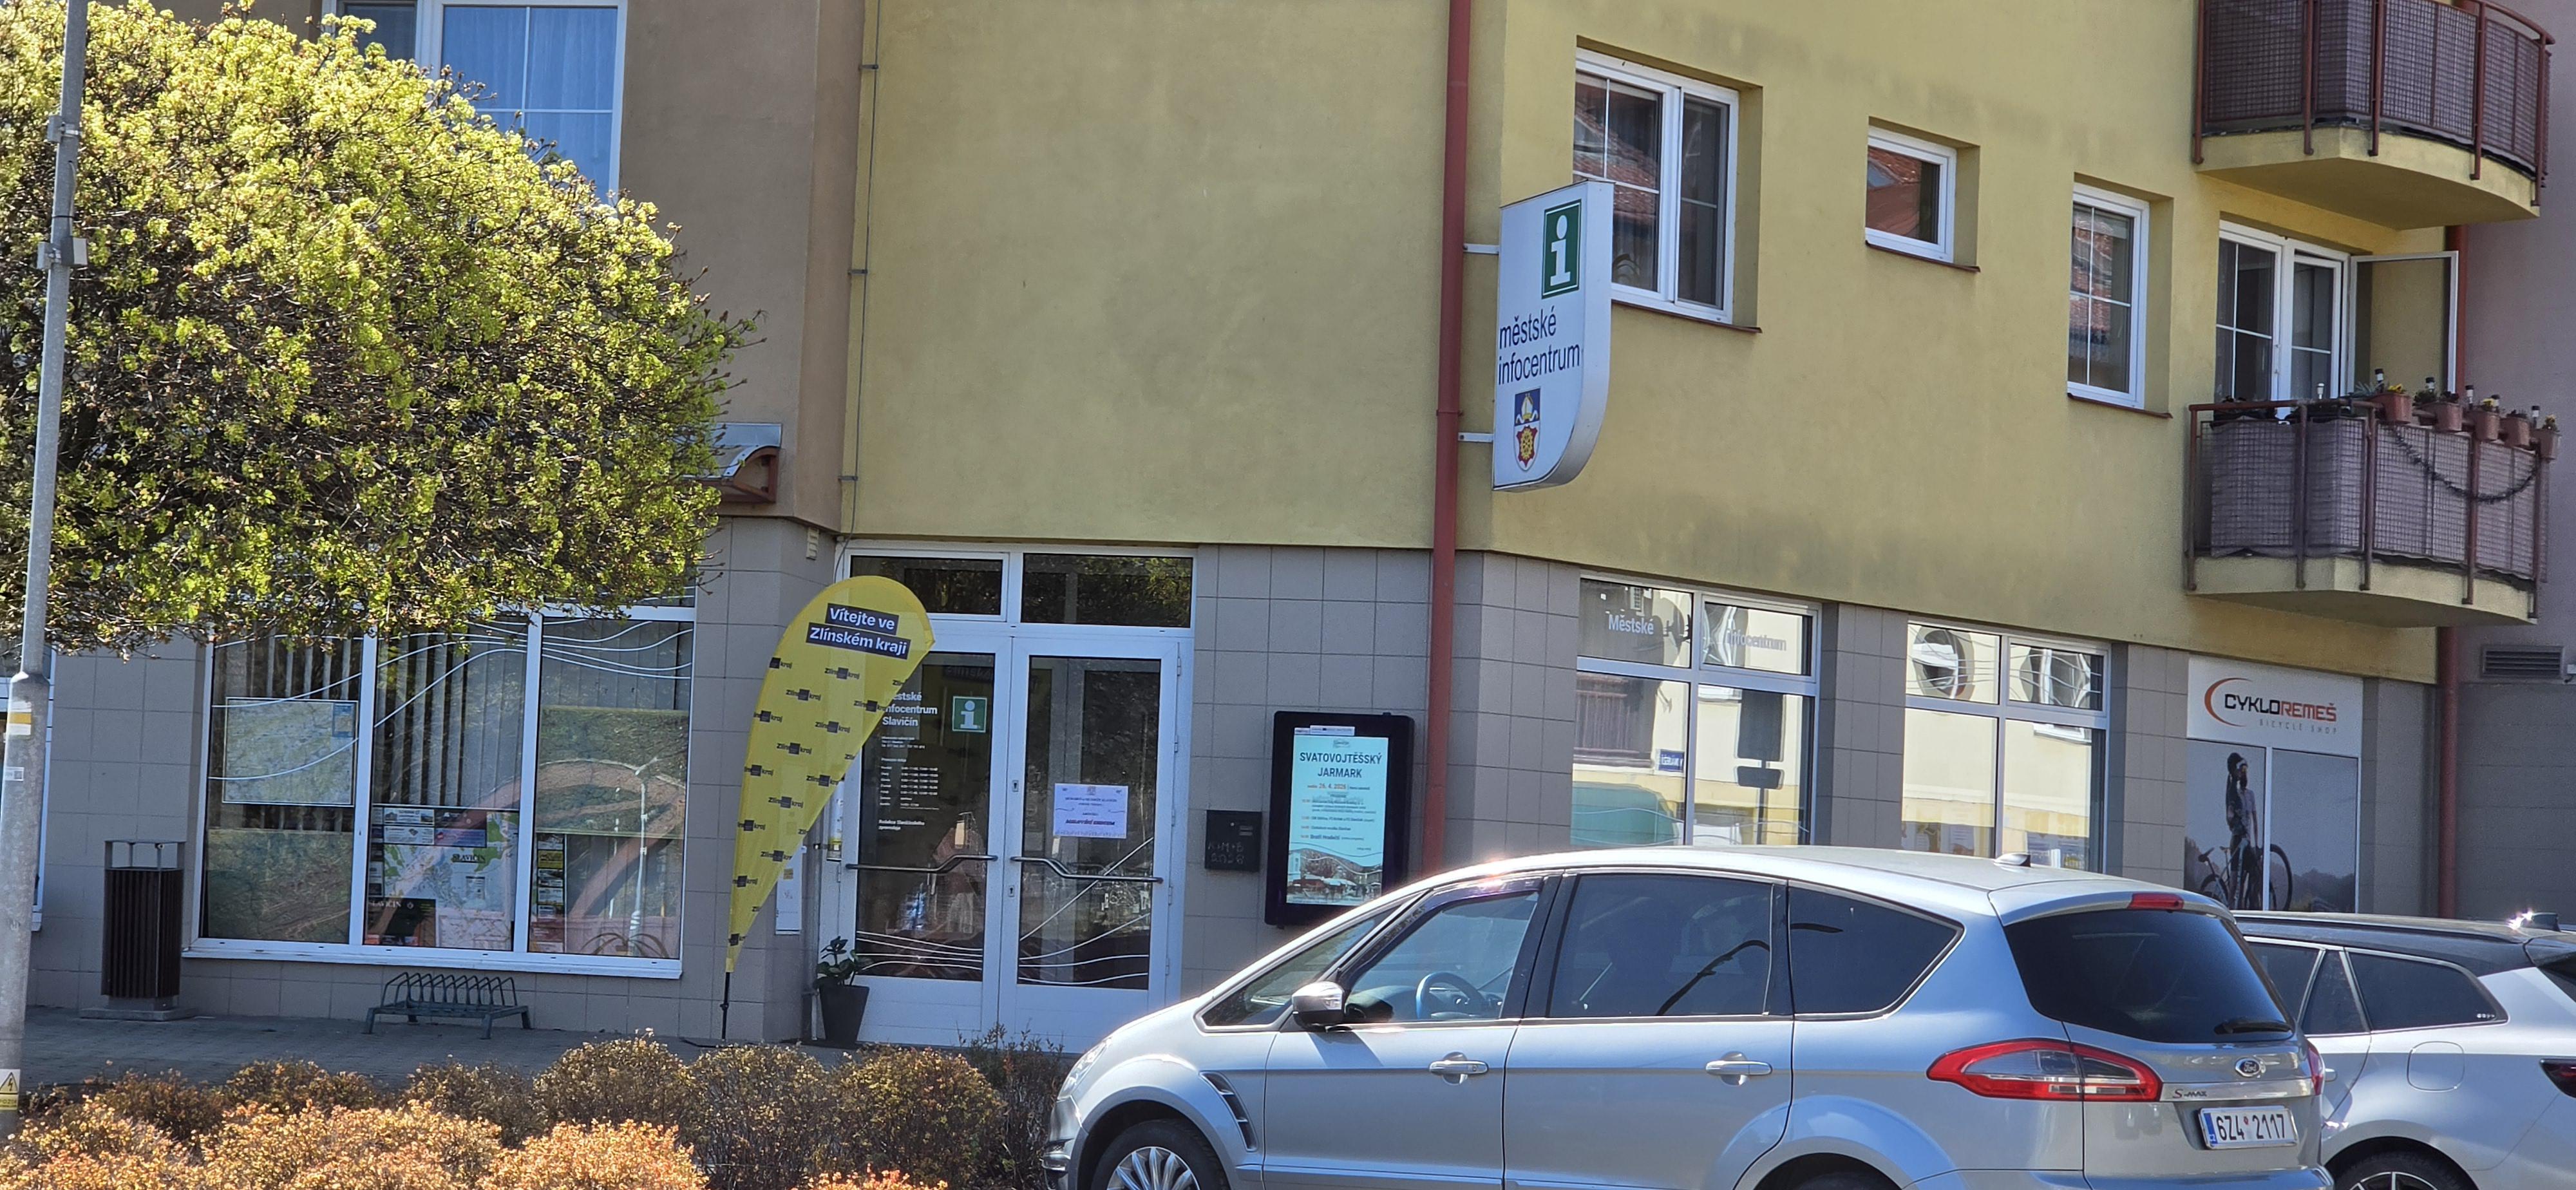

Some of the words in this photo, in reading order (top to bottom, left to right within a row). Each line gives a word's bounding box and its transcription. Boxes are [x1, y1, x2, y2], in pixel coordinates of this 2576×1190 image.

[1499, 305, 1557, 349] městské
[1498, 344, 1580, 385] infocentrum
[829, 607, 876, 627] Vítejte
[878, 618, 895, 630] ve
[1608, 614, 1654, 635] Městské
[810, 627, 873, 648] Zlínském
[875, 637, 907, 656] kraji
[886, 703, 938, 714] nfocentrum
[2224, 694, 2337, 722] CYKLOREMEŠ
[882, 717, 919, 726] Slavičín
[2259, 719, 2303, 732] BICYCLE
[2311, 726, 2338, 735] SHOP
[1300, 752, 1383, 764] SVATOVOJTĚŠSKÝ
[1318, 768, 1363, 778] JARMARK
[2216, 1115, 2245, 1140] 6Z4
[2252, 1113, 2285, 1140] 2117
